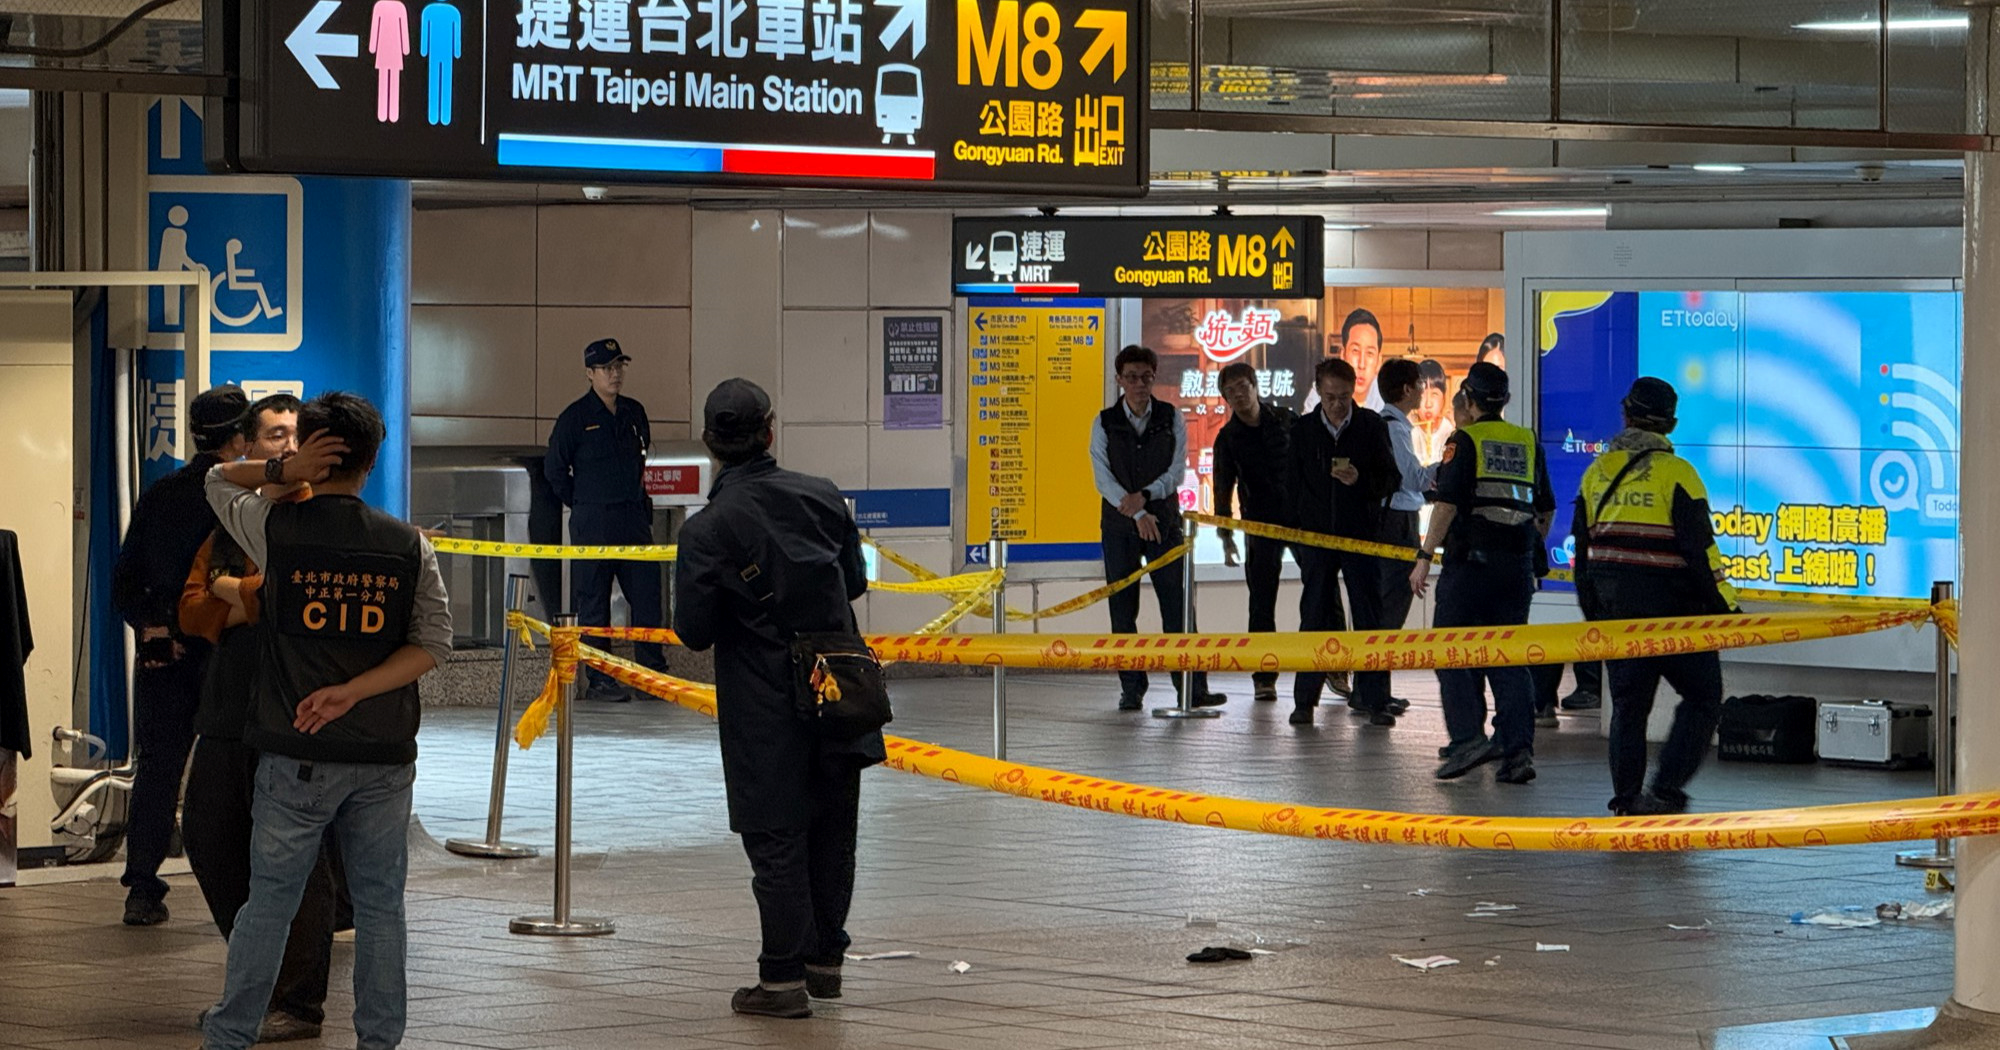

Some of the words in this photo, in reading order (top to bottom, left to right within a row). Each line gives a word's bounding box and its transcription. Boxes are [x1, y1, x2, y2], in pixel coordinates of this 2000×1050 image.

[514, 0, 863, 65] 捷運台北車站
[956, 0, 1062, 90] M8
[512, 63, 583, 102] MRT
[590, 67, 676, 113] Taipei
[685, 71, 754, 111] Main
[762, 75, 863, 115] Station
[979, 99, 1064, 138] 公園路
[1074, 94, 1124, 167] 出口
[953, 140, 1035, 166] Gongyuan
[1037, 144, 1064, 164] Rd.
[1100, 146, 1125, 165] EXIT
[1020, 230, 1066, 262] 捷運
[1143, 230, 1212, 262] 公園路
[1217, 234, 1267, 278] M8
[1020, 265, 1052, 283] MRT
[1115, 266, 1184, 287] Gongyuan
[1188, 267, 1212, 283] Rd.
[1198, 309, 1275, 348] 統一麵
[1661, 309, 1738, 332] ETtoday
[989, 336, 1000, 344] M1
[1072, 336, 1084, 345] M8
[989, 348, 1000, 358] M2
[989, 361, 1000, 371] M3
[989, 375, 1000, 384] M4
[1180, 367, 1295, 398] 熟悉美味
[989, 397, 1000, 406] M5
[989, 410, 1000, 420] M6
[988, 435, 999, 444] M7
[1487, 458, 1526, 476] POLICE
[1592, 492, 1654, 508] PLICE
[1711, 505, 1772, 543] oday
[1776, 503, 1888, 545] 網路廣播
[1720, 551, 1771, 580] cast
[291, 569, 399, 591] 臺北市政府警察局
[305, 586, 386, 604] 中正第一分局
[303, 601, 385, 634] CID
[1363, 649, 1437, 671] 刑案現場
[1926, 872, 1937, 888] 50
